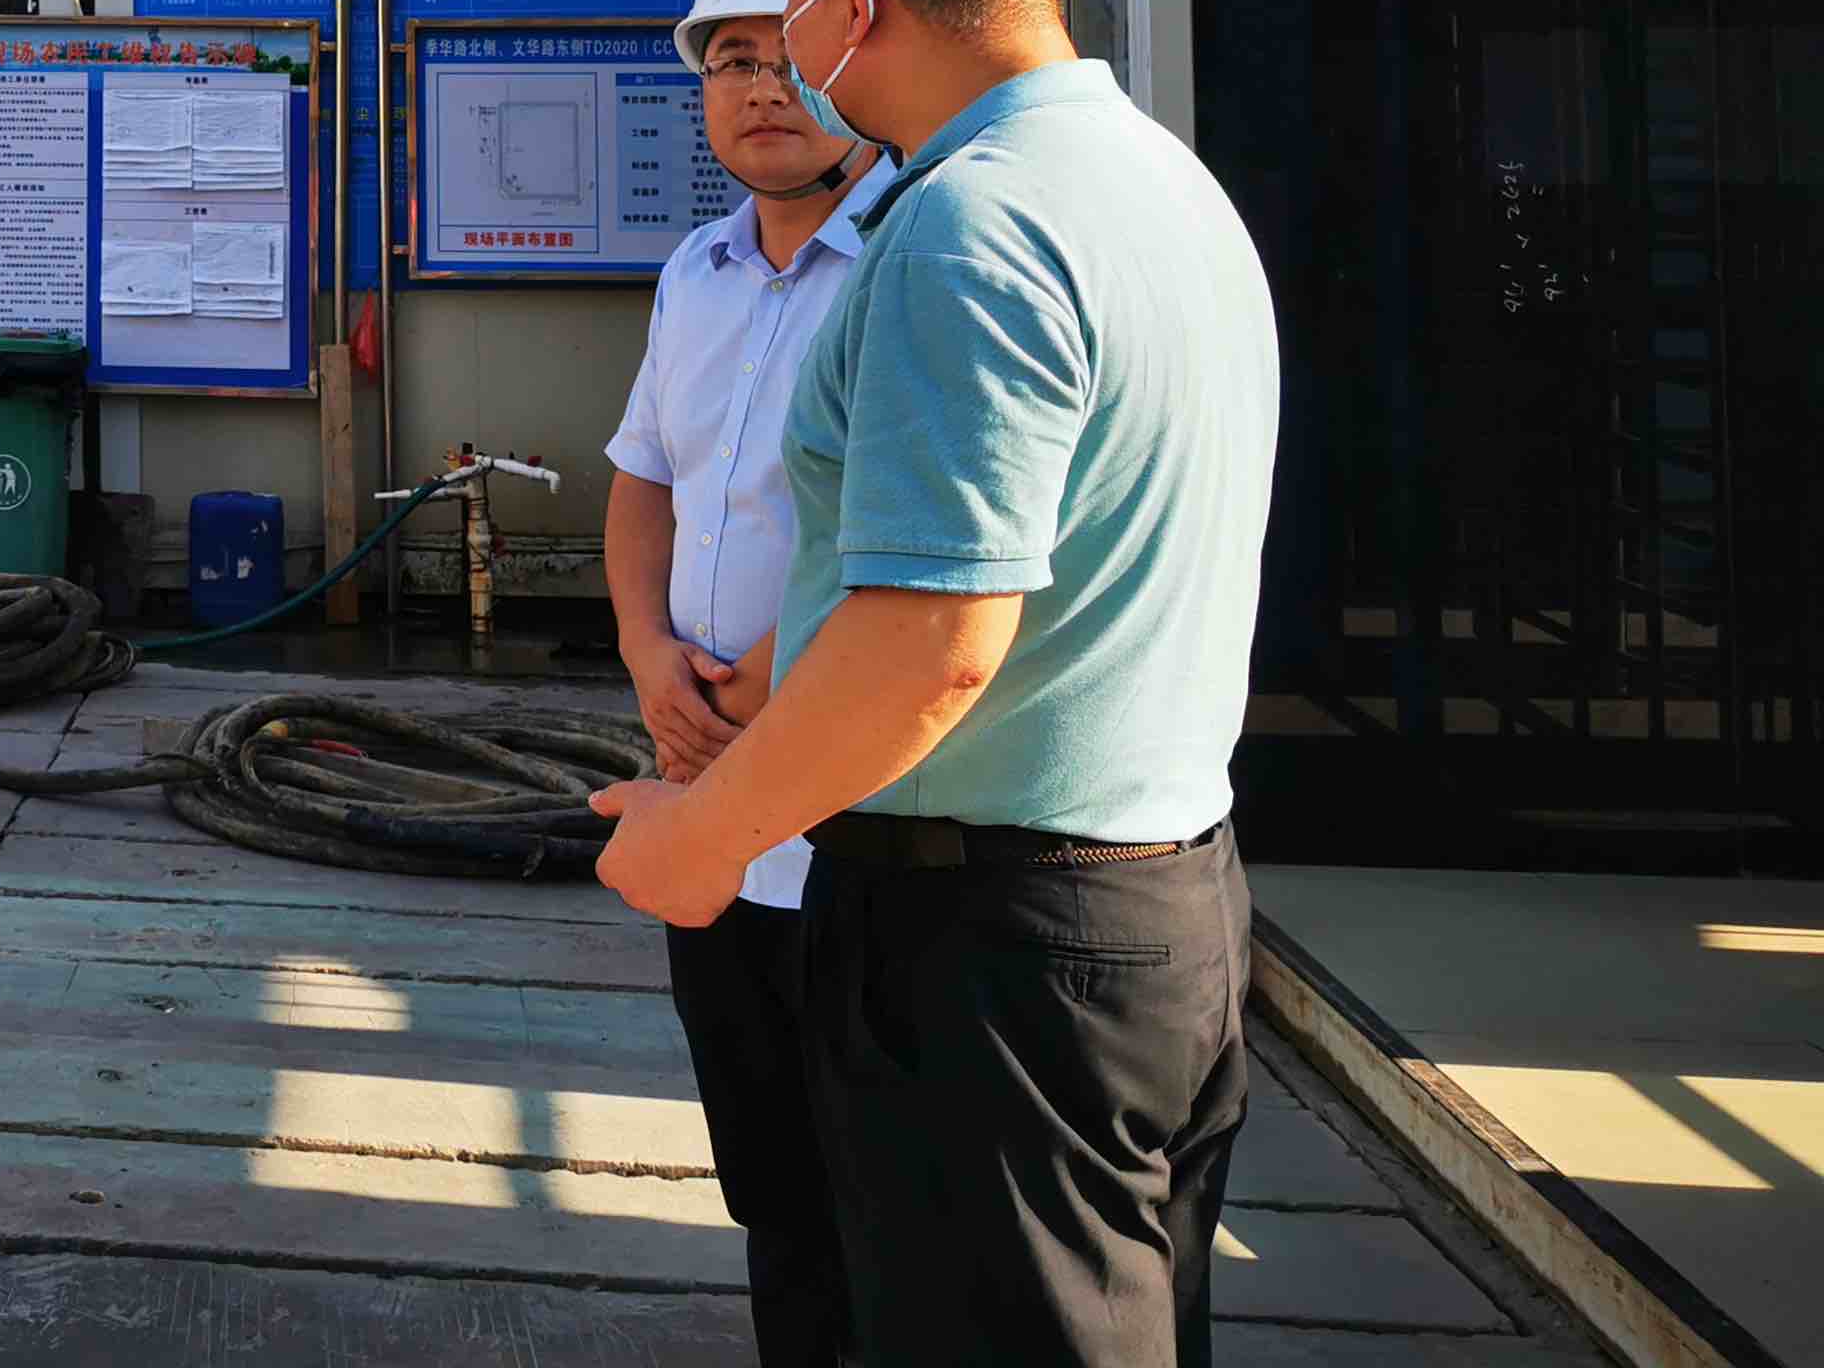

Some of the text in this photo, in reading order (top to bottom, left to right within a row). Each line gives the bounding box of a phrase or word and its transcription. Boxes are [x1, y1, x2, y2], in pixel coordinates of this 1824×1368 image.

[463, 231, 575, 248] 现场平面布置图
